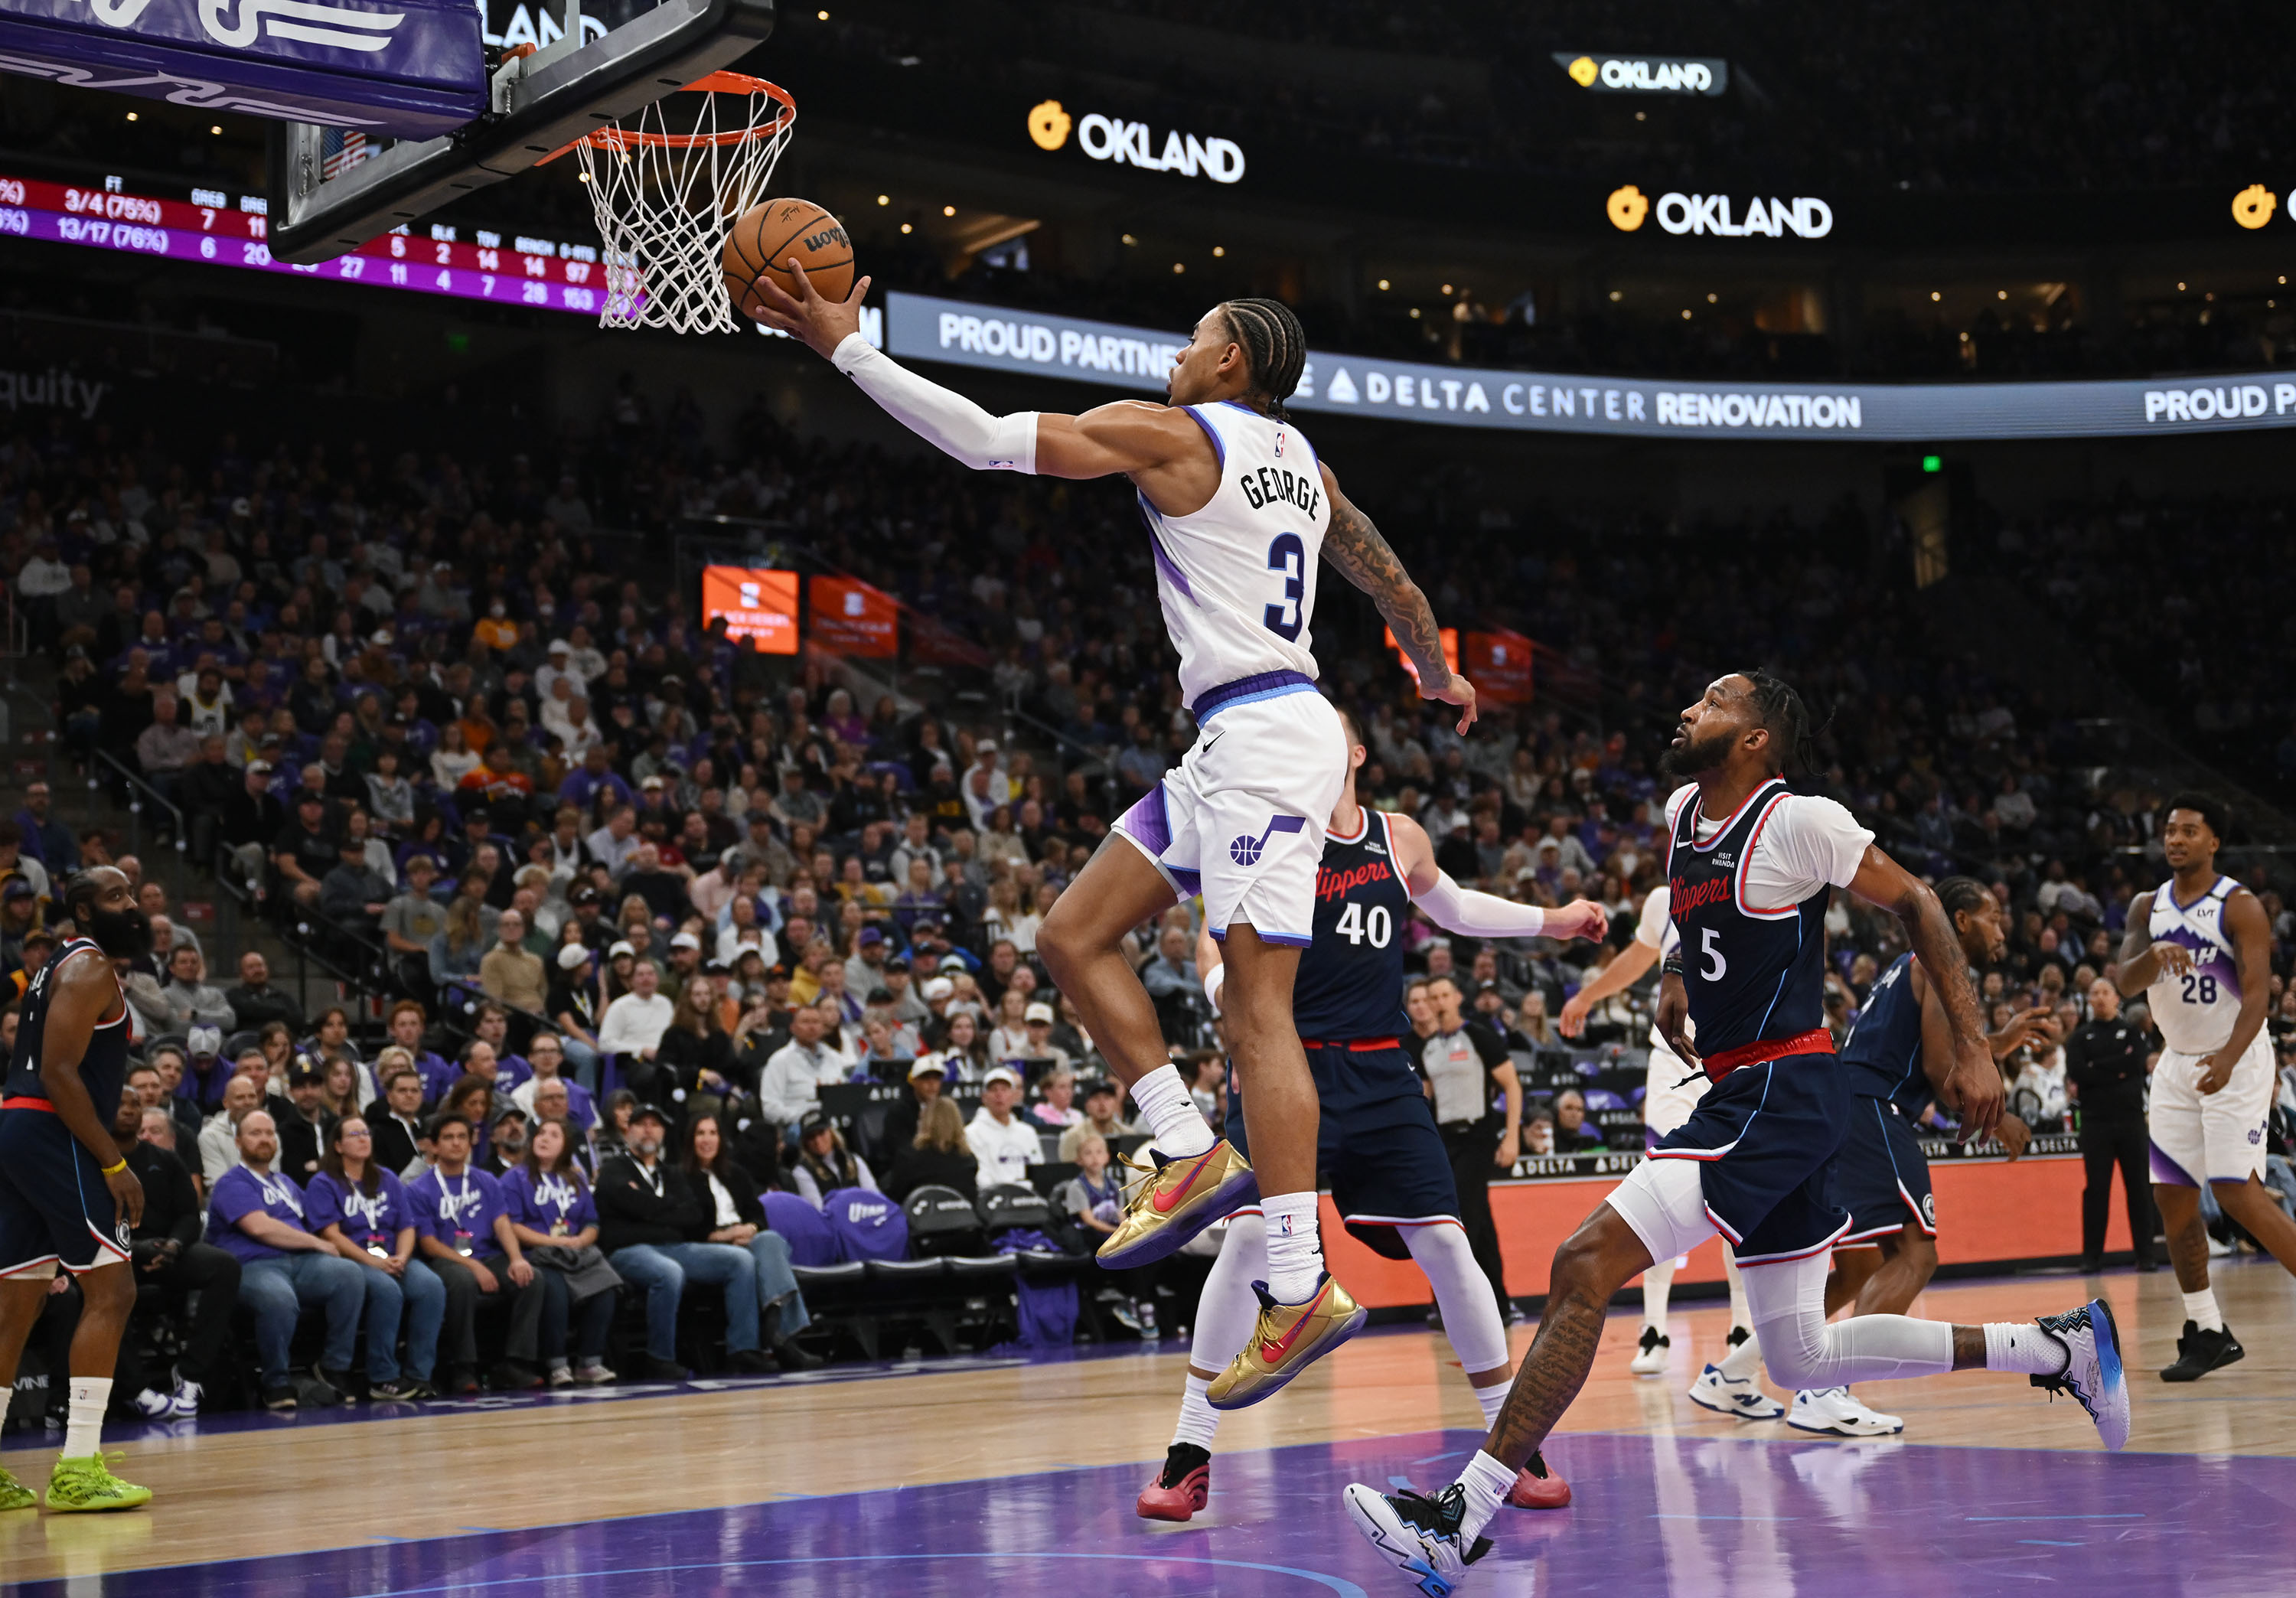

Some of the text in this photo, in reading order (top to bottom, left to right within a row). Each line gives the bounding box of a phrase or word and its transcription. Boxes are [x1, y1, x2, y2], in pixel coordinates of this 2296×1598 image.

[1600, 60, 1713, 91] OKLAND
[1078, 113, 1246, 184] OKLAND
[64, 188, 162, 226] 3/4 (75%)
[201, 208, 217, 230] 7
[1655, 191, 1834, 239] OKLAND
[57, 215, 112, 245] 13/17
[113, 223, 169, 255] (76%)
[247, 216, 266, 238] 11
[200, 236, 217, 259] 6
[243, 241, 271, 266] 20
[390, 236, 407, 258] 5
[435, 243, 452, 265] 2
[339, 255, 366, 279] 27
[475, 249, 500, 272] 14
[523, 256, 546, 278] 14
[565, 261, 591, 284] 97
[389, 262, 408, 285] 11
[435, 269, 452, 292] 4
[481, 274, 497, 297] 7
[938, 311, 1057, 364] PROUD
[1365, 370, 1863, 429] DELTA CENTER RENOVATION
[2144, 384, 2268, 422] PROUD
[1240, 466, 1321, 522] GEORGE
[1263, 531, 1306, 644] 3
[1711, 858, 1735, 869] RWANDA
[1717, 852, 1732, 860] VISIT
[1669, 875, 1731, 925] Clippers
[2197, 908, 2216, 918] LVT
[1335, 902, 1392, 949] 40
[1700, 927, 1727, 982] 5
[2180, 974, 2217, 1004] 28
[1526, 1157, 1576, 1176] DELTA
